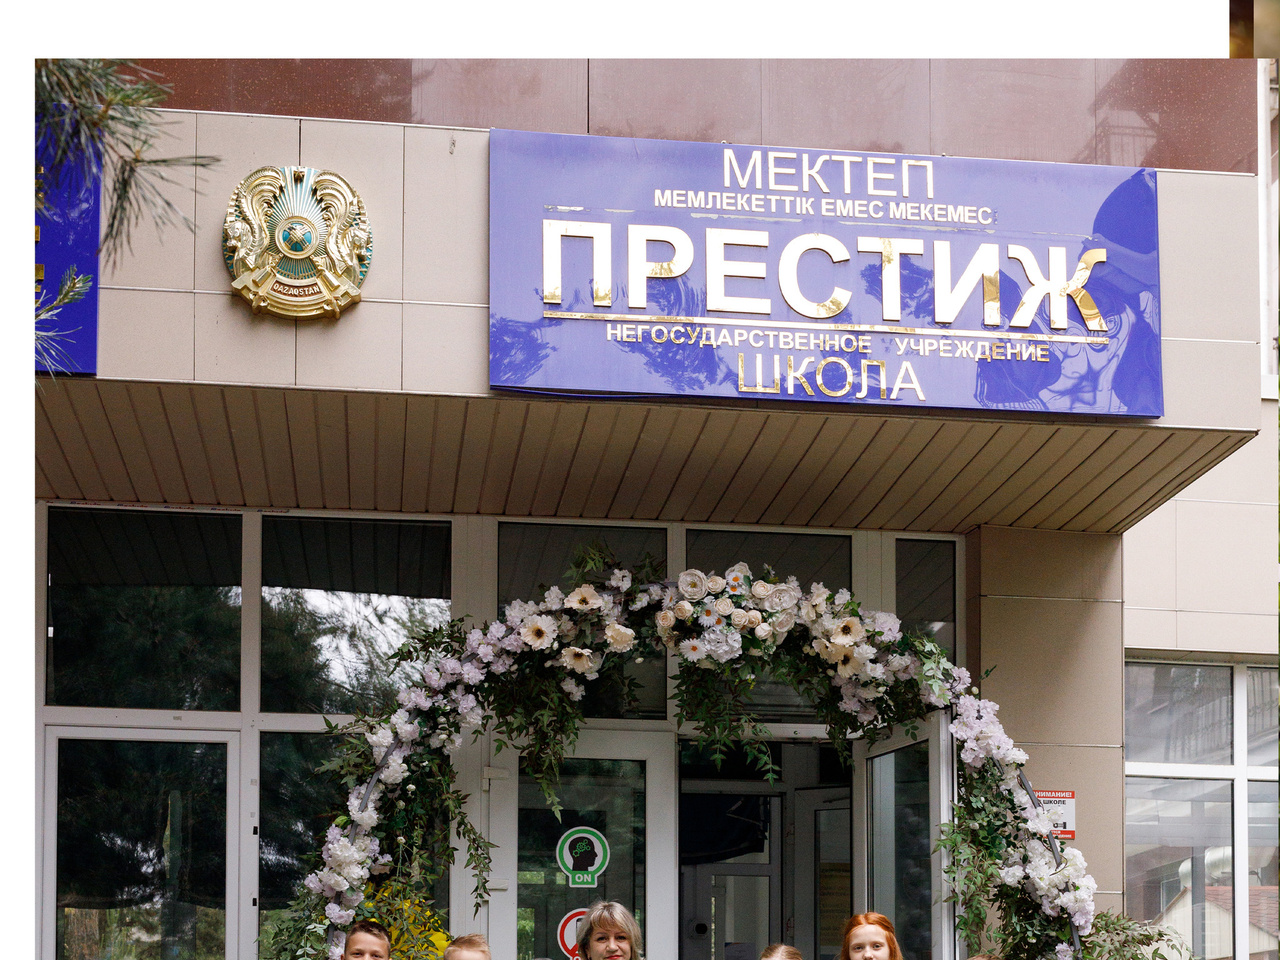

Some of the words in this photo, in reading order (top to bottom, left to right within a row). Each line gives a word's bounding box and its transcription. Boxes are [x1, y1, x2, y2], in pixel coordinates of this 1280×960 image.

[722, 148, 935, 199] МЕКТЕП
[821, 197, 884, 220] ЕМЕС
[889, 202, 993, 225] МЕКЕМЕС
[542, 218, 1107, 332] ПРЕСТИЖ
[606, 323, 872, 354] НЕГОСУДАРСТВЕННОЕ
[895, 336, 1050, 363] УЧРЕЖДЕНИЕ
[737, 352, 926, 402] ШКОЛА
[575, 873, 592, 883] ON
